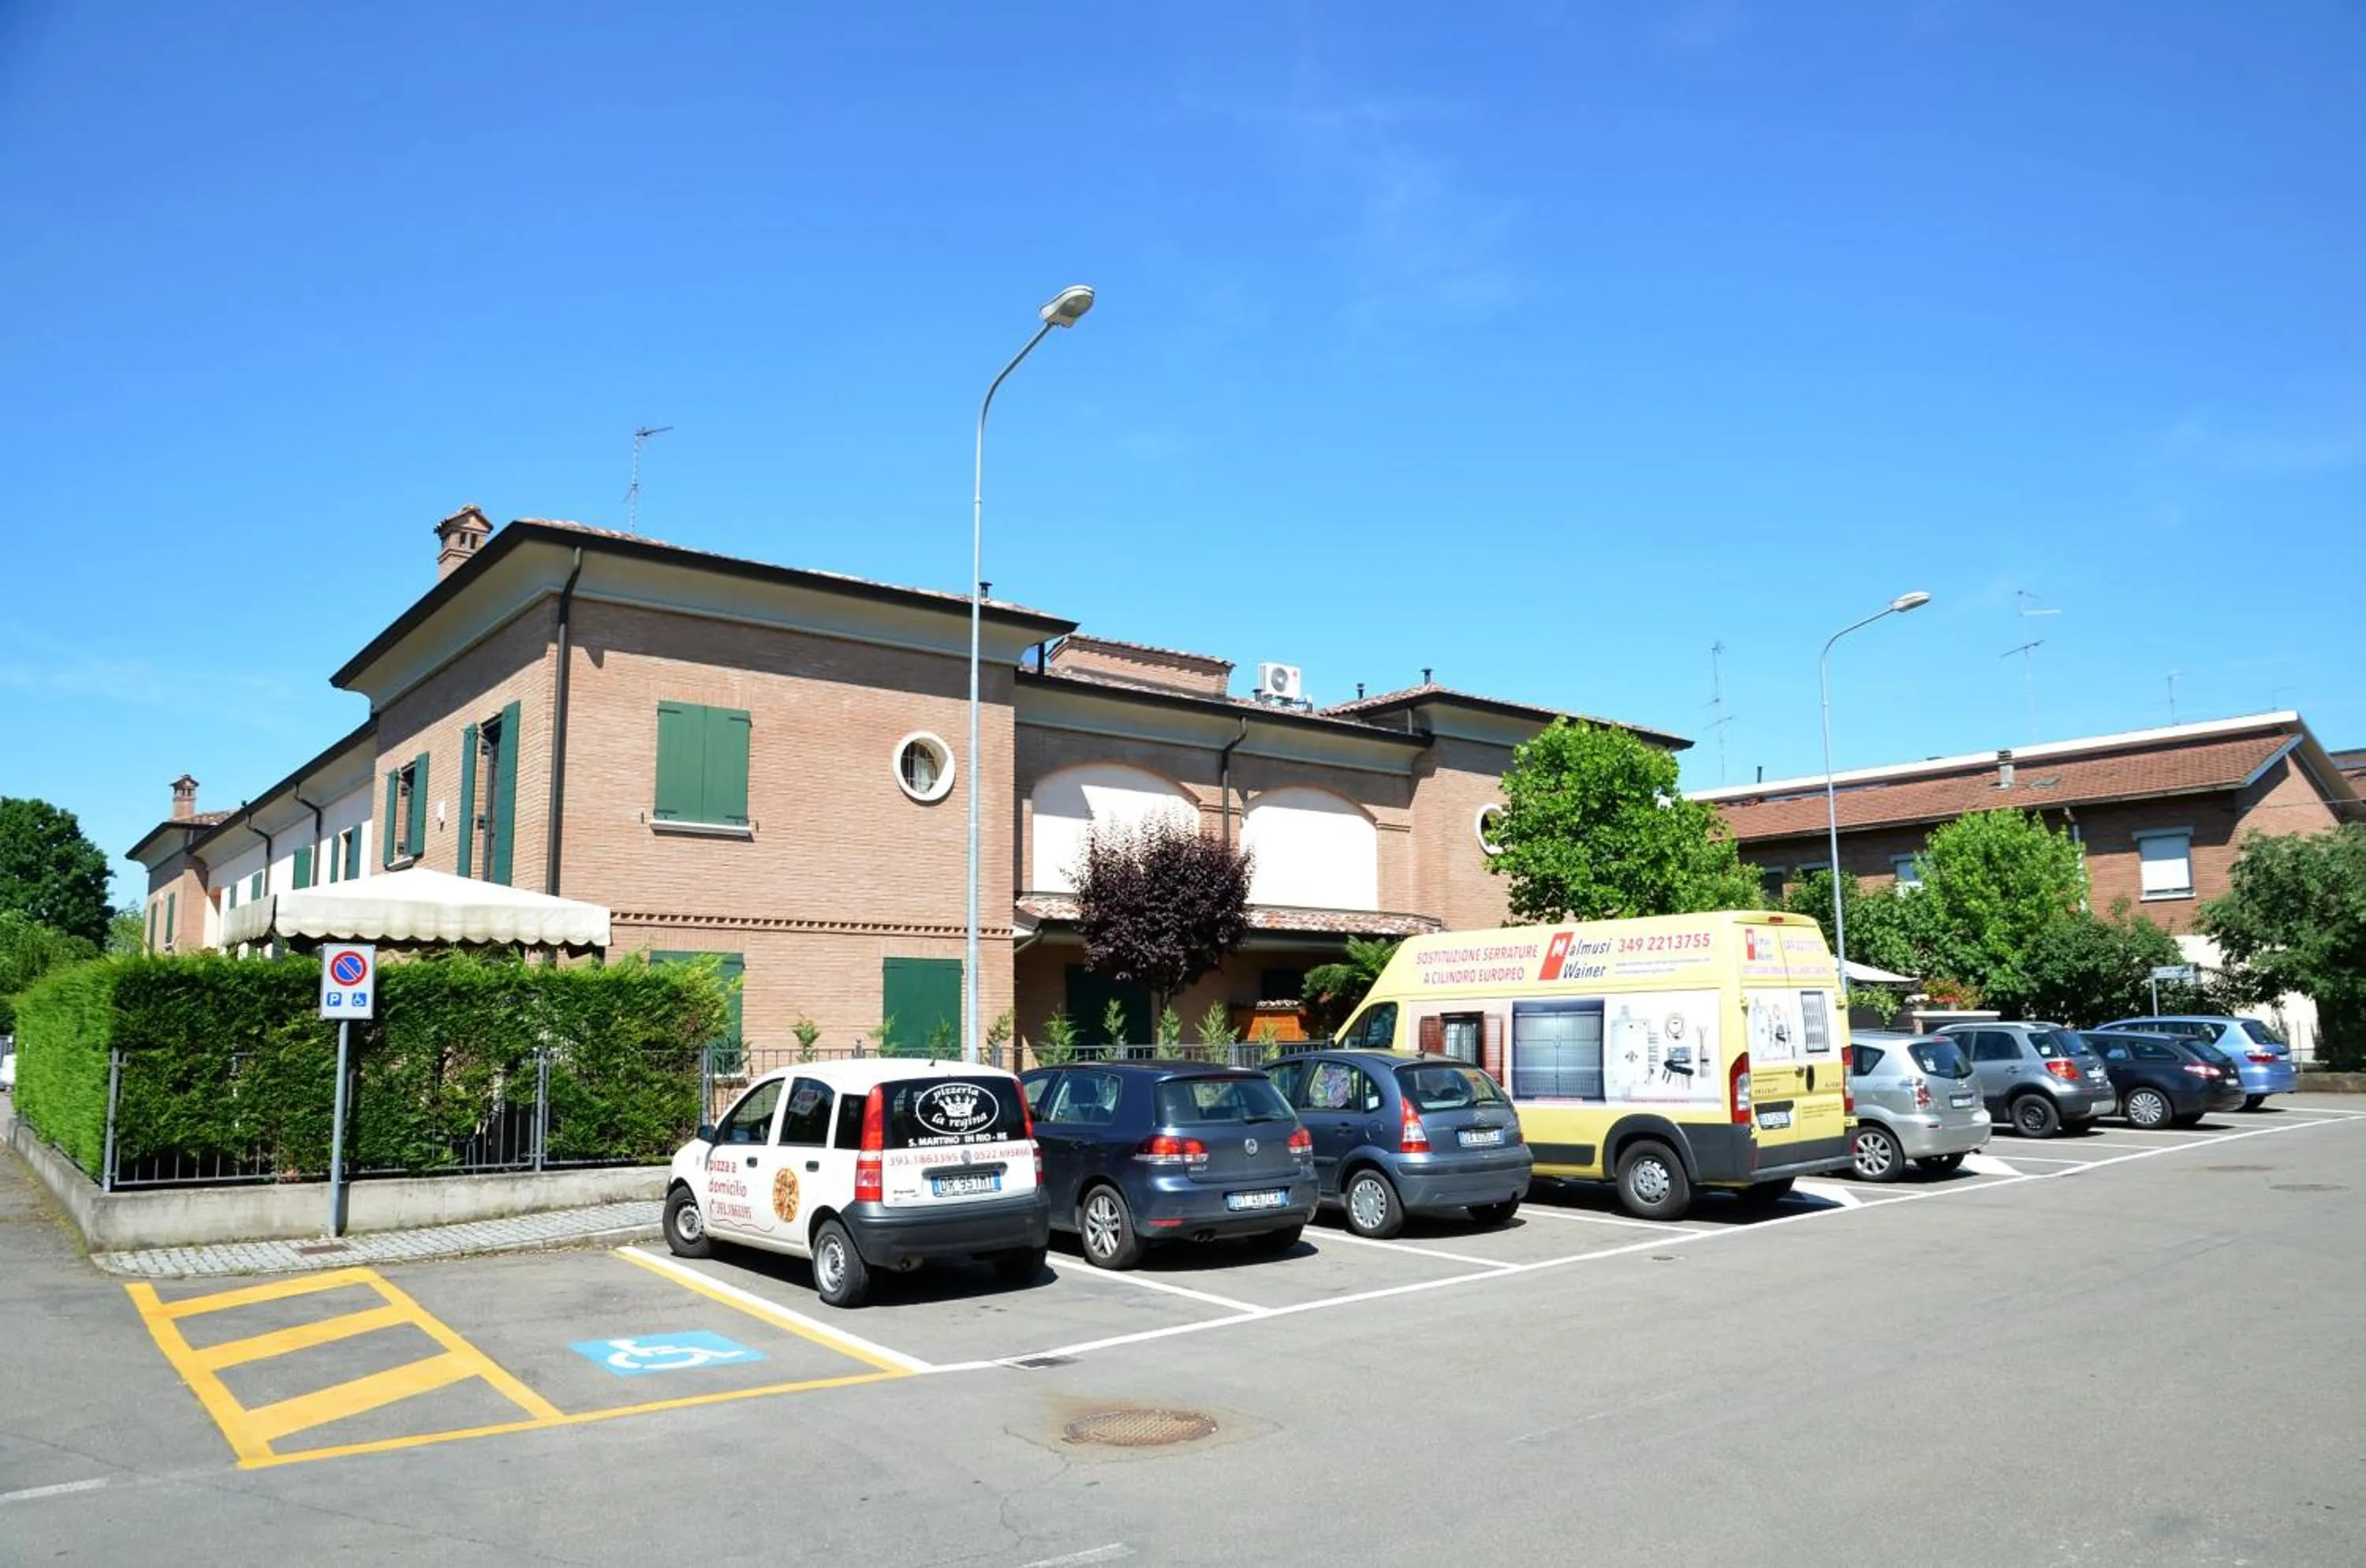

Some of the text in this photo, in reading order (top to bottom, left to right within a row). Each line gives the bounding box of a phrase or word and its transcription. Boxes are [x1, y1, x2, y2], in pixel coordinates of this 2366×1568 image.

[1618, 932, 1711, 954] 349 2213755
[1416, 945, 1539, 965] SOSTITUZIONE SERRATURE
[1424, 966, 1525, 985] A CILINDRO EUROPEO
[1562, 961, 1607, 980] Wainer
[329, 993, 339, 1005] P
[931, 1086, 980, 1104] pizzeria
[949, 1112, 988, 1131] regina
[908, 1138, 917, 1148] S.
[918, 1136, 960, 1146] MARTINO
[965, 1134, 975, 1144] IN
[976, 1133, 991, 1143] RIO
[996, 1132, 1008, 1141] RE
[708, 1178, 747, 1197] domicilio
